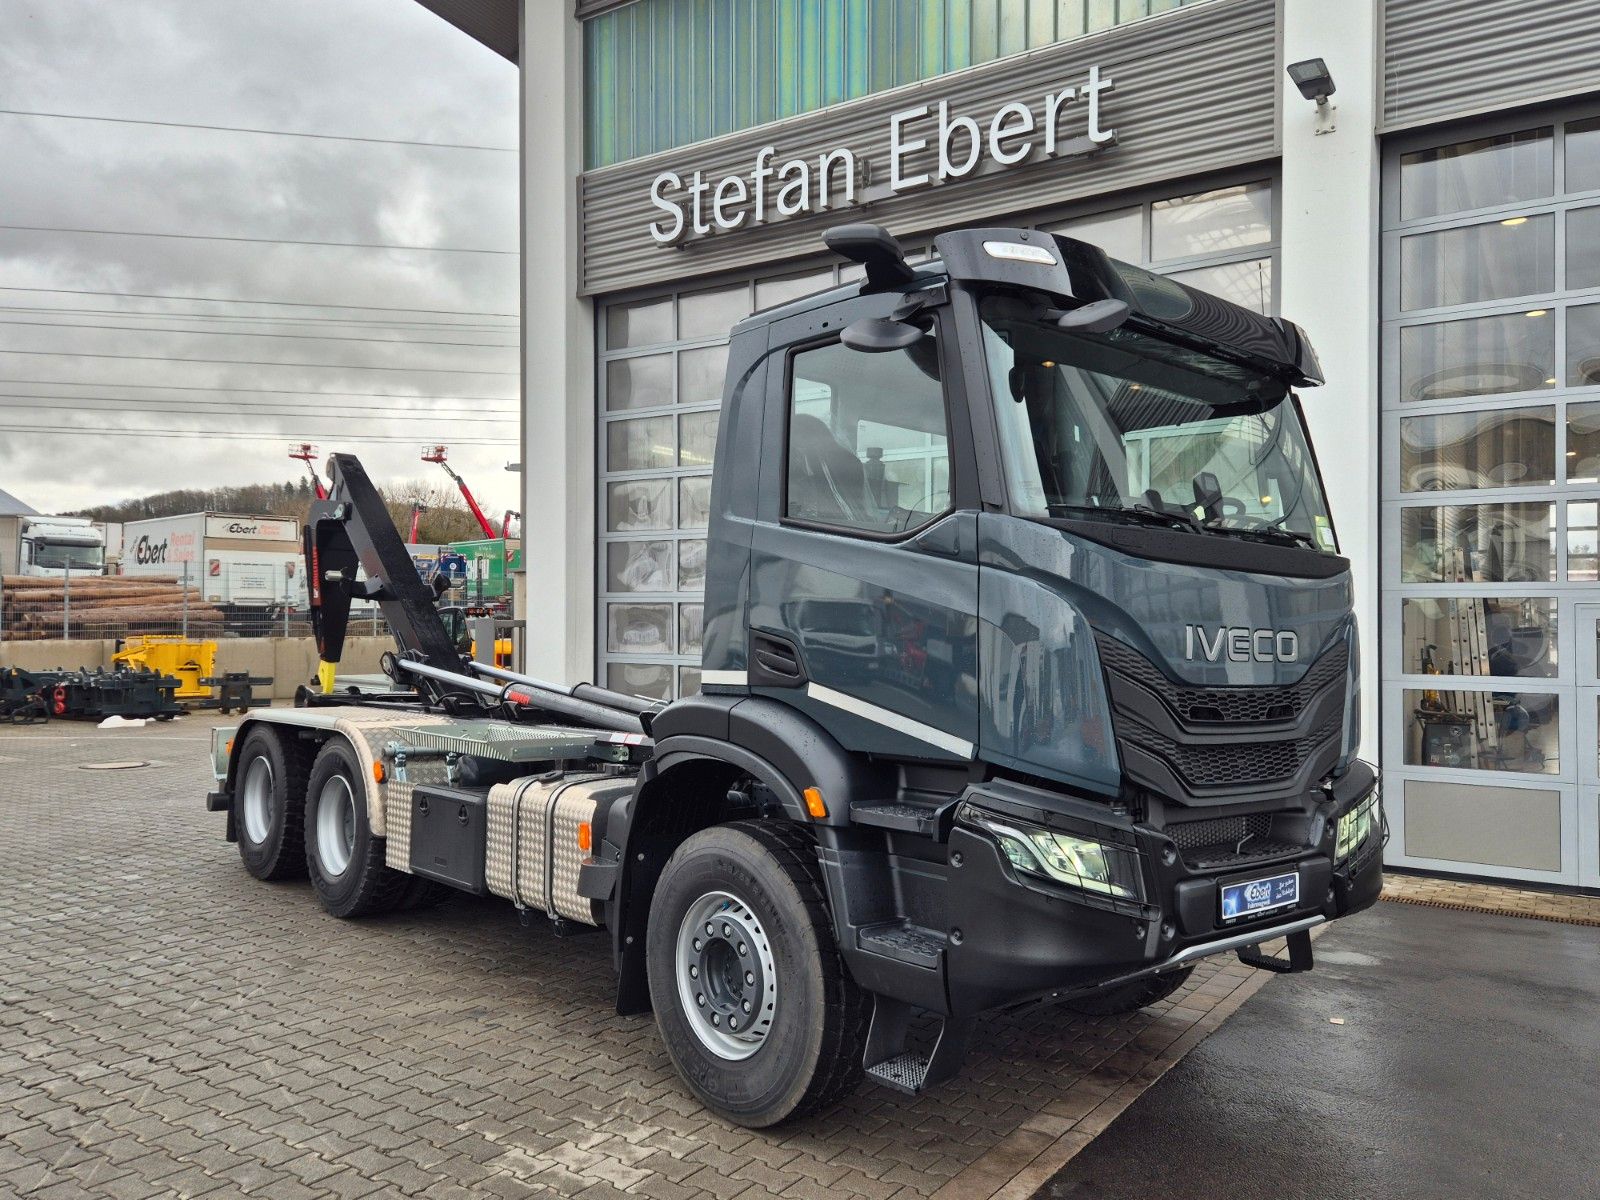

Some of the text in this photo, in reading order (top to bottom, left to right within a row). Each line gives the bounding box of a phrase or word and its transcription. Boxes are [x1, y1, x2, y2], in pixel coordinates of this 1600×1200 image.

[649, 65, 1116, 244] Stefan Ebert
[171, 531, 195, 545] Rental
[229, 522, 258, 534] Ebert
[137, 534, 168, 565] Ebert
[1185, 624, 1299, 663] IVECO
[1250, 883, 1271, 899] Ebert
